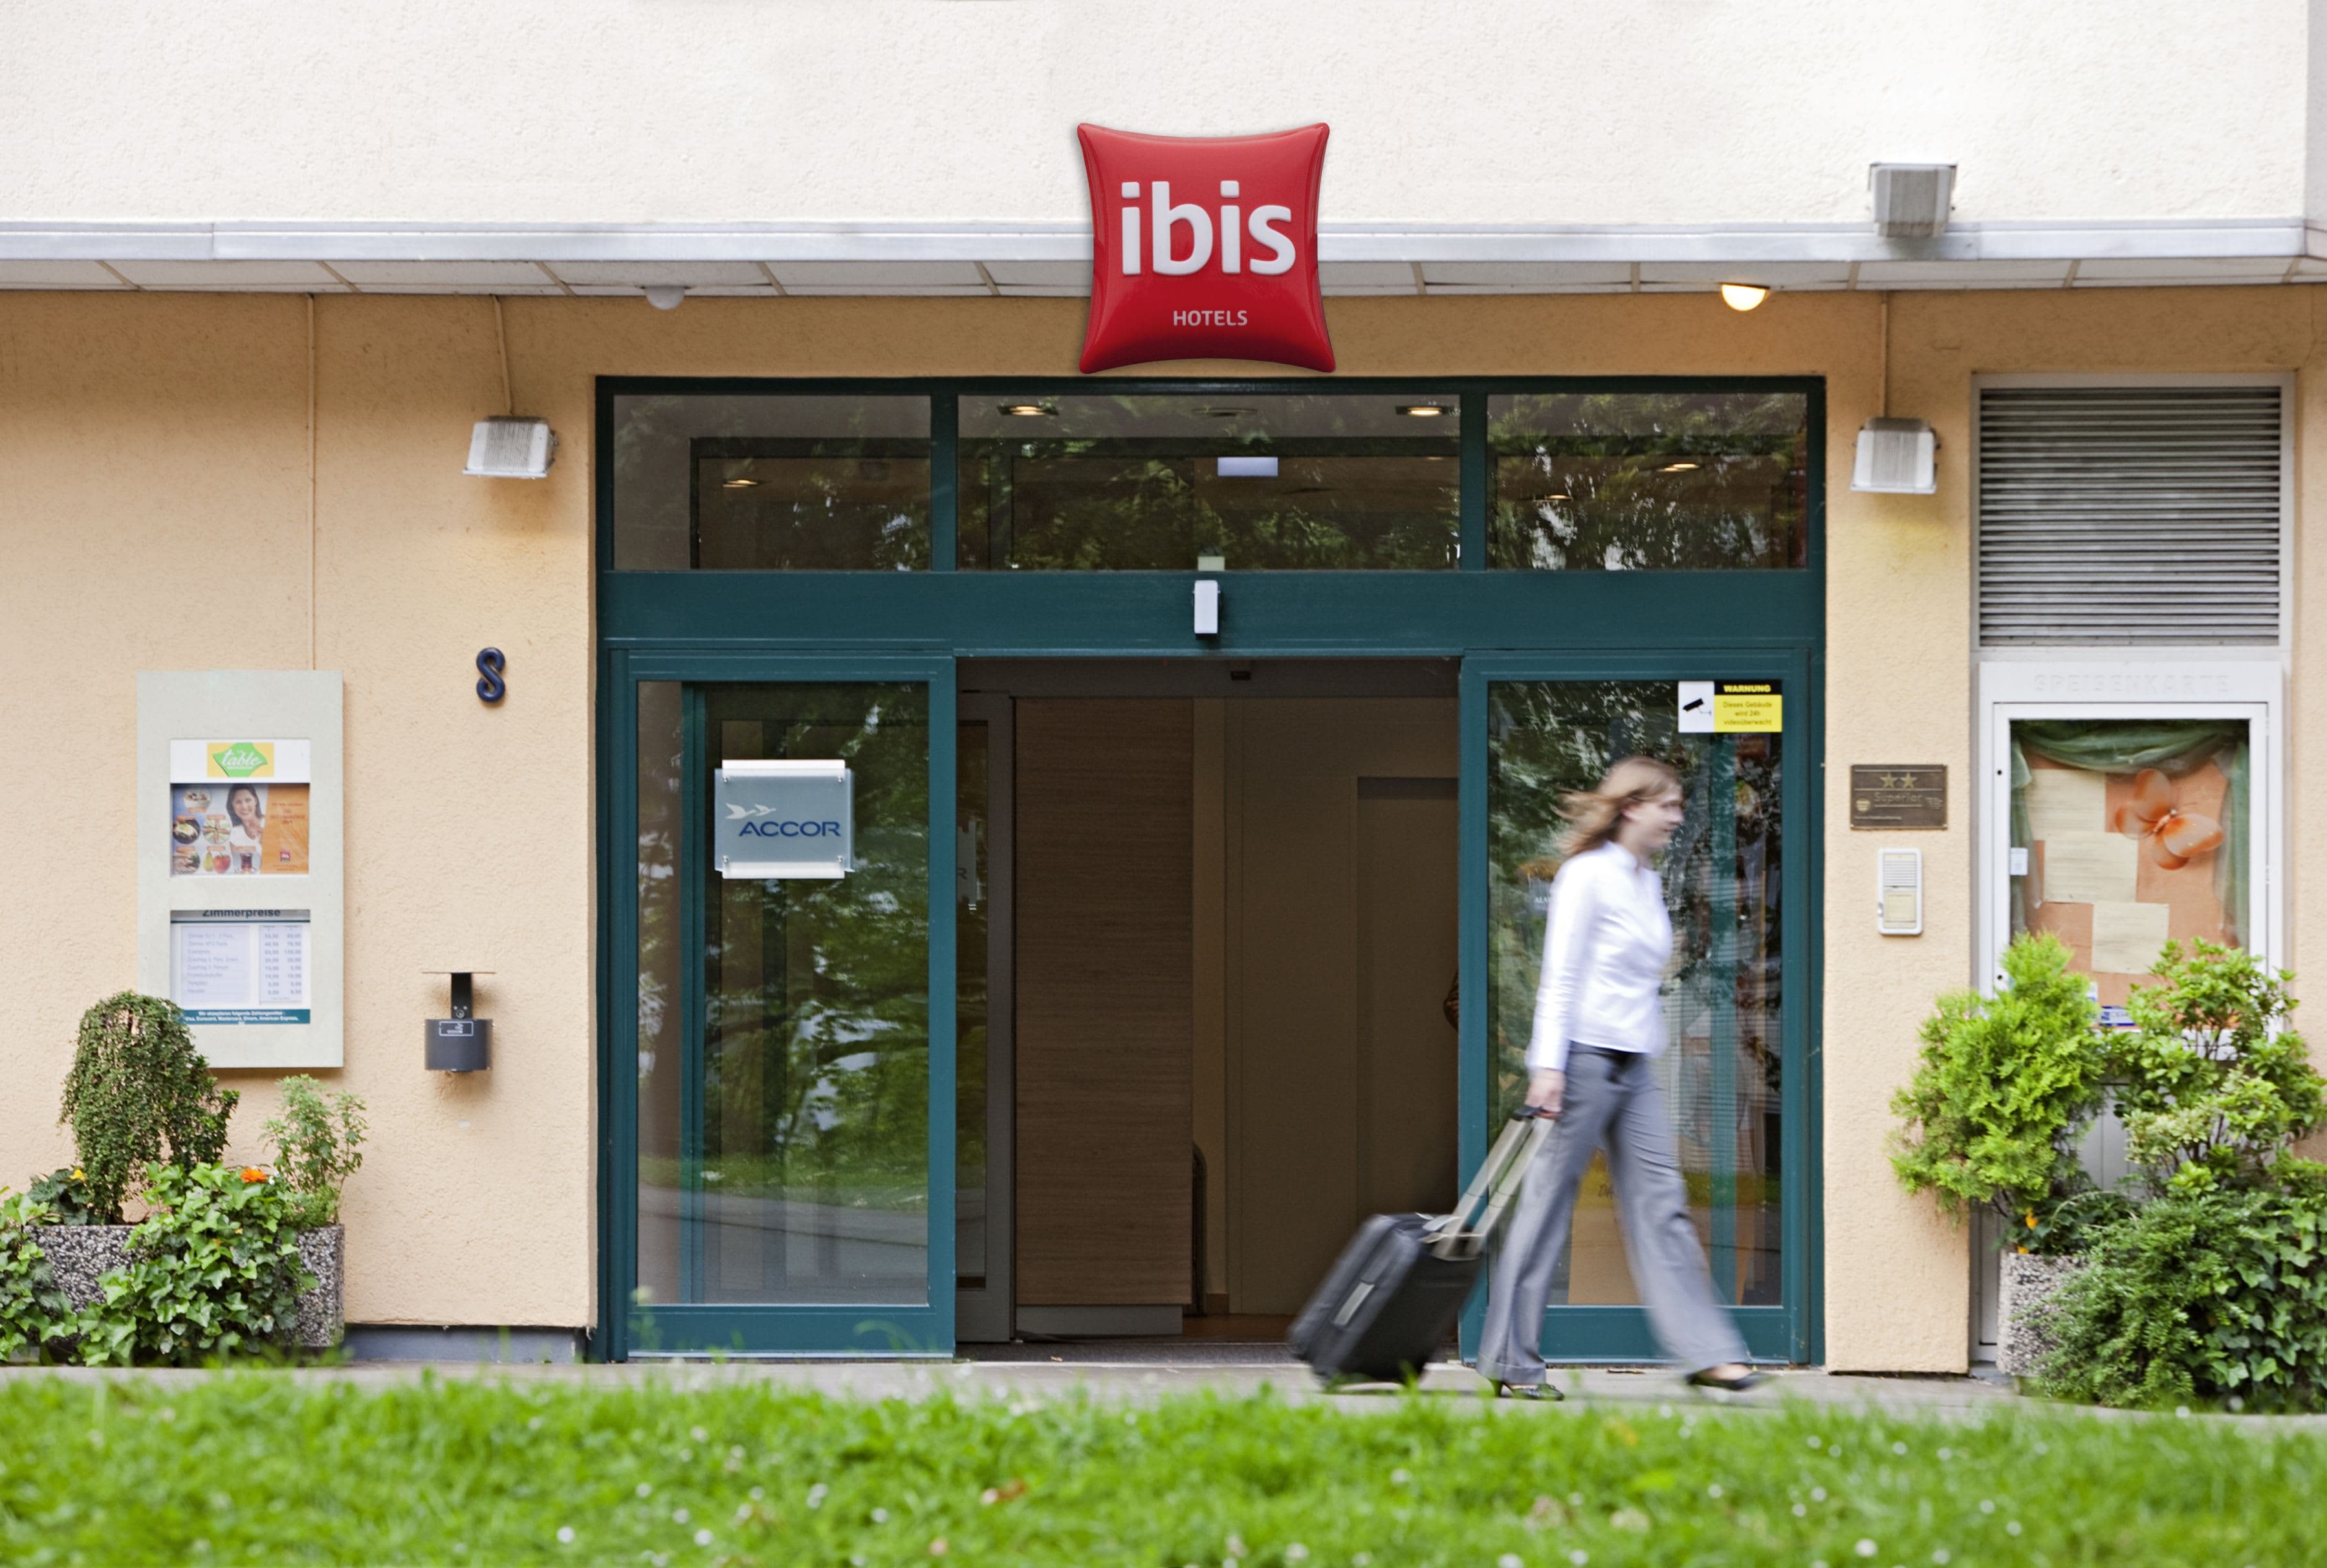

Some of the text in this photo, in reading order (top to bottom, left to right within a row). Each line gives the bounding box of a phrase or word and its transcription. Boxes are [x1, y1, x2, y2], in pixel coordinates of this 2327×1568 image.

[1121, 180, 1296, 276] ibis
[1173, 310, 1248, 327] HOTELS
[476, 647, 506, 702] 8
[1723, 684, 1771, 693] WARNUNG
[2034, 674, 2231, 694] SPEISENKARTE
[222, 748, 262, 767] table
[1874, 792, 1923, 803] Superior
[739, 821, 840, 837] ACCOR
[202, 909, 281, 919] Zimmerpreise
